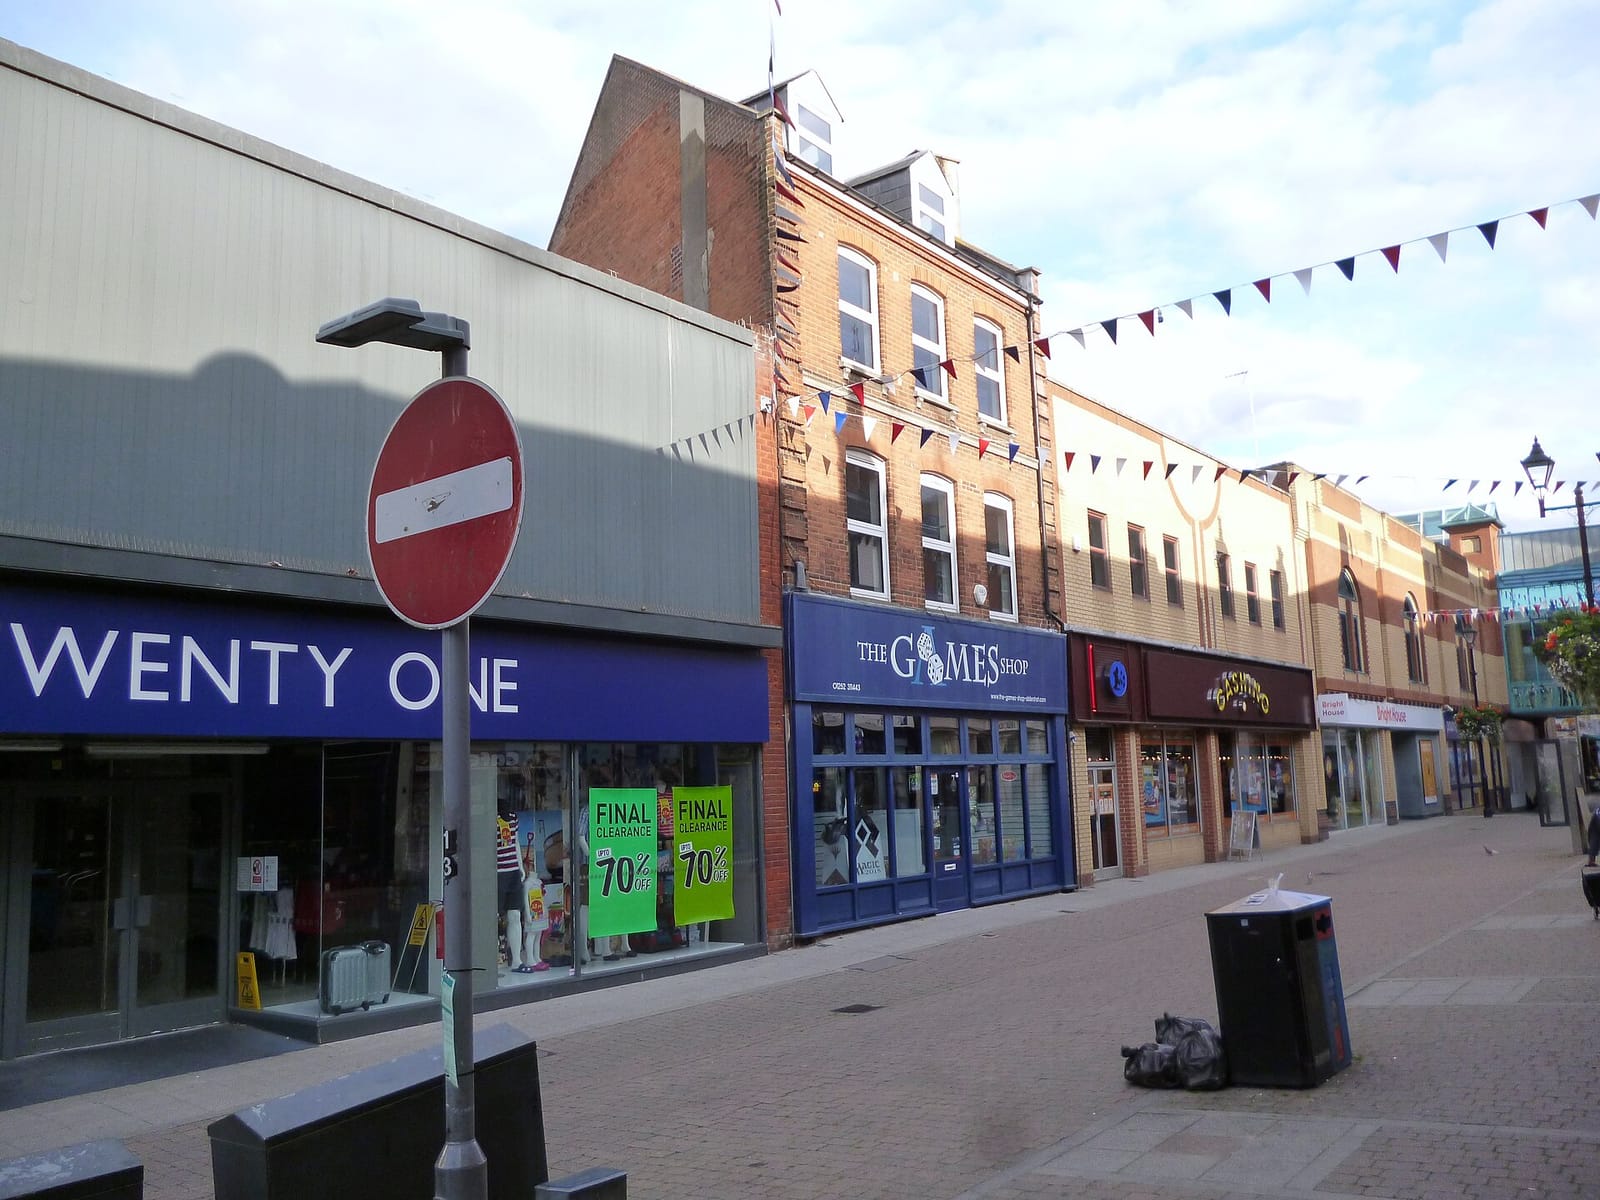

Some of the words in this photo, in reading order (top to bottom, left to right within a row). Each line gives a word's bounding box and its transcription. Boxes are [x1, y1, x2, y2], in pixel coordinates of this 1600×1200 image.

[857, 641, 888, 664] THE
[890, 625, 999, 689] GAMES
[1000, 658, 1029, 675] SHOP
[10, 623, 353, 708] WENTY
[1322, 700, 1344, 708] Bright
[596, 803, 651, 825] FINAL
[679, 799, 728, 821] FINAL
[596, 826, 651, 838] CLEARANCE
[679, 820, 728, 833] CLEARANCE
[713, 869, 729, 881] OFF
[634, 878, 652, 891] OFF
